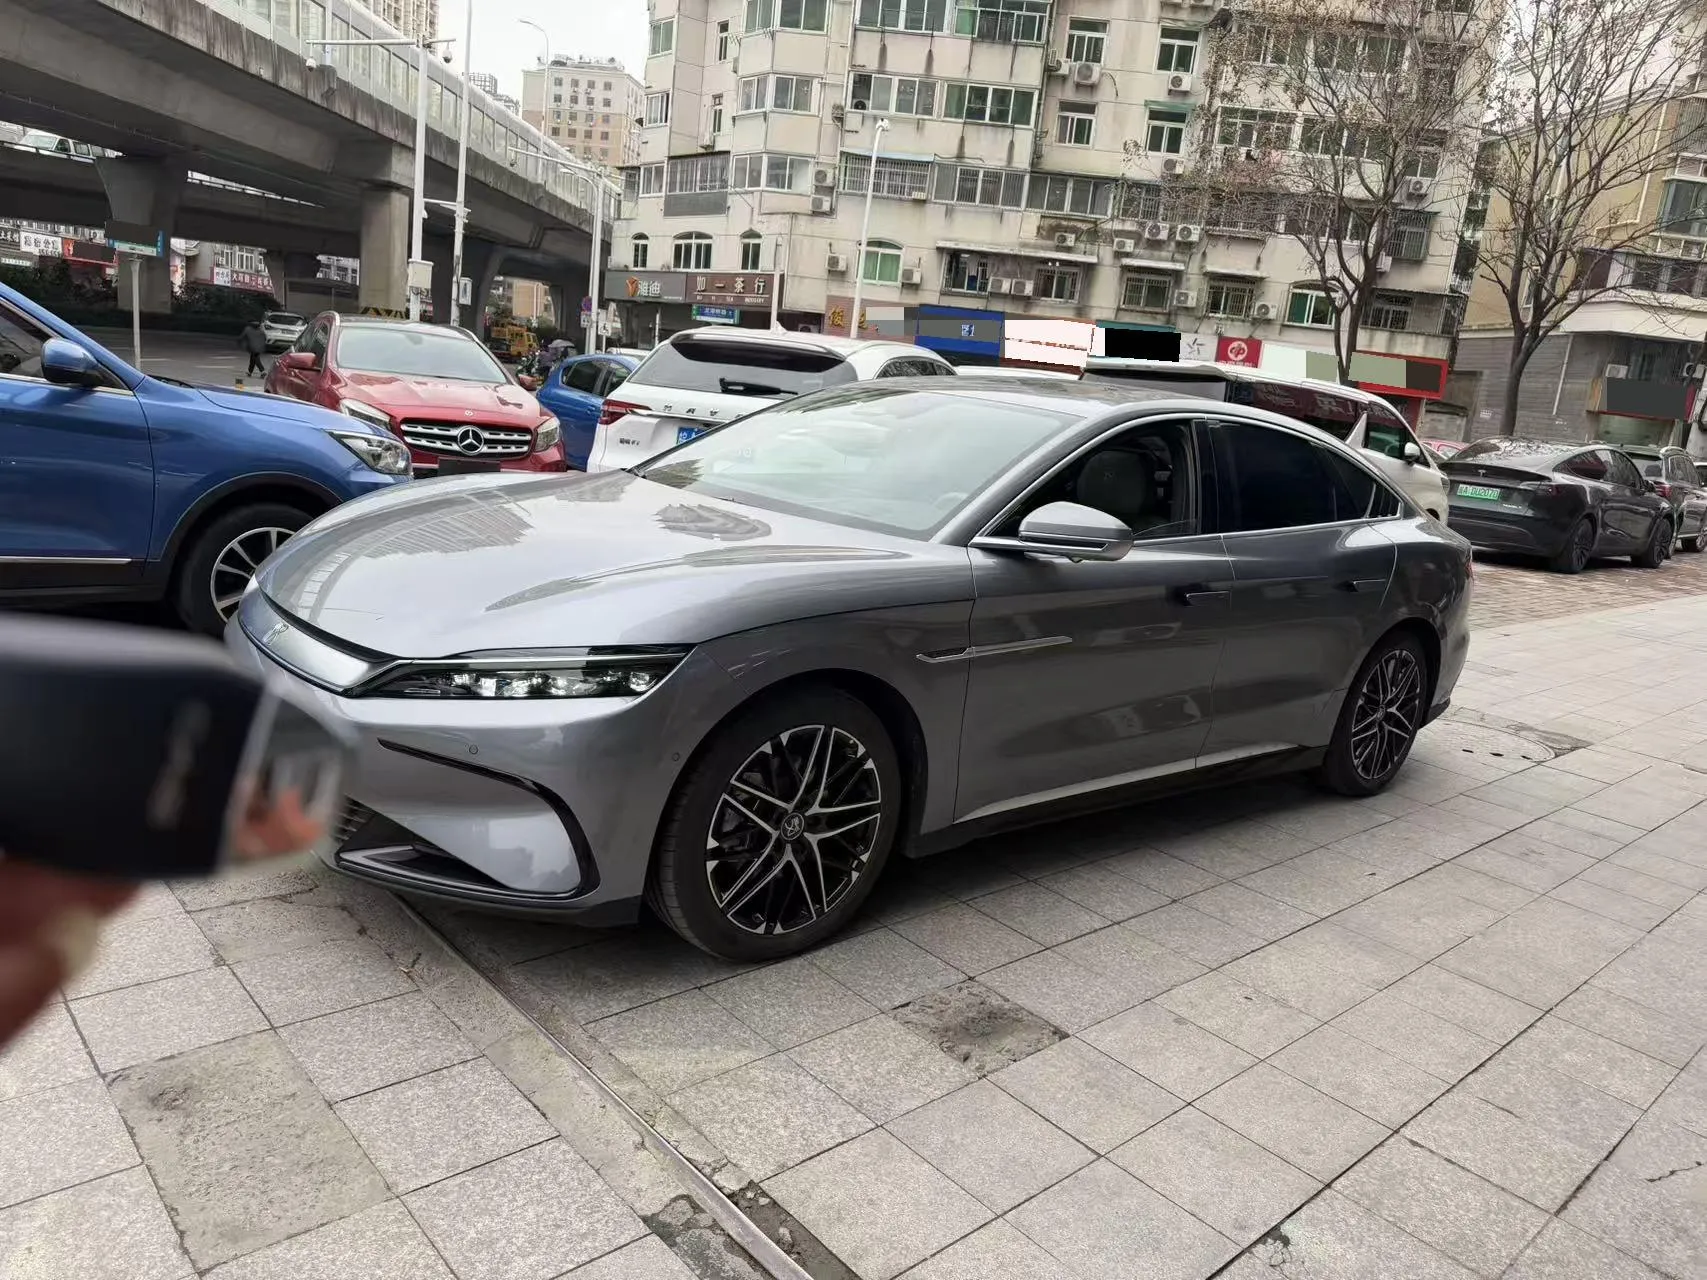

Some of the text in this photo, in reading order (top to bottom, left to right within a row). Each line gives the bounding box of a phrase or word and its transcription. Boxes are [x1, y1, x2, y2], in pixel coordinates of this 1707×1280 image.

[637, 280, 661, 297] 雅迪
[696, 276, 765, 294] 如一茶行
